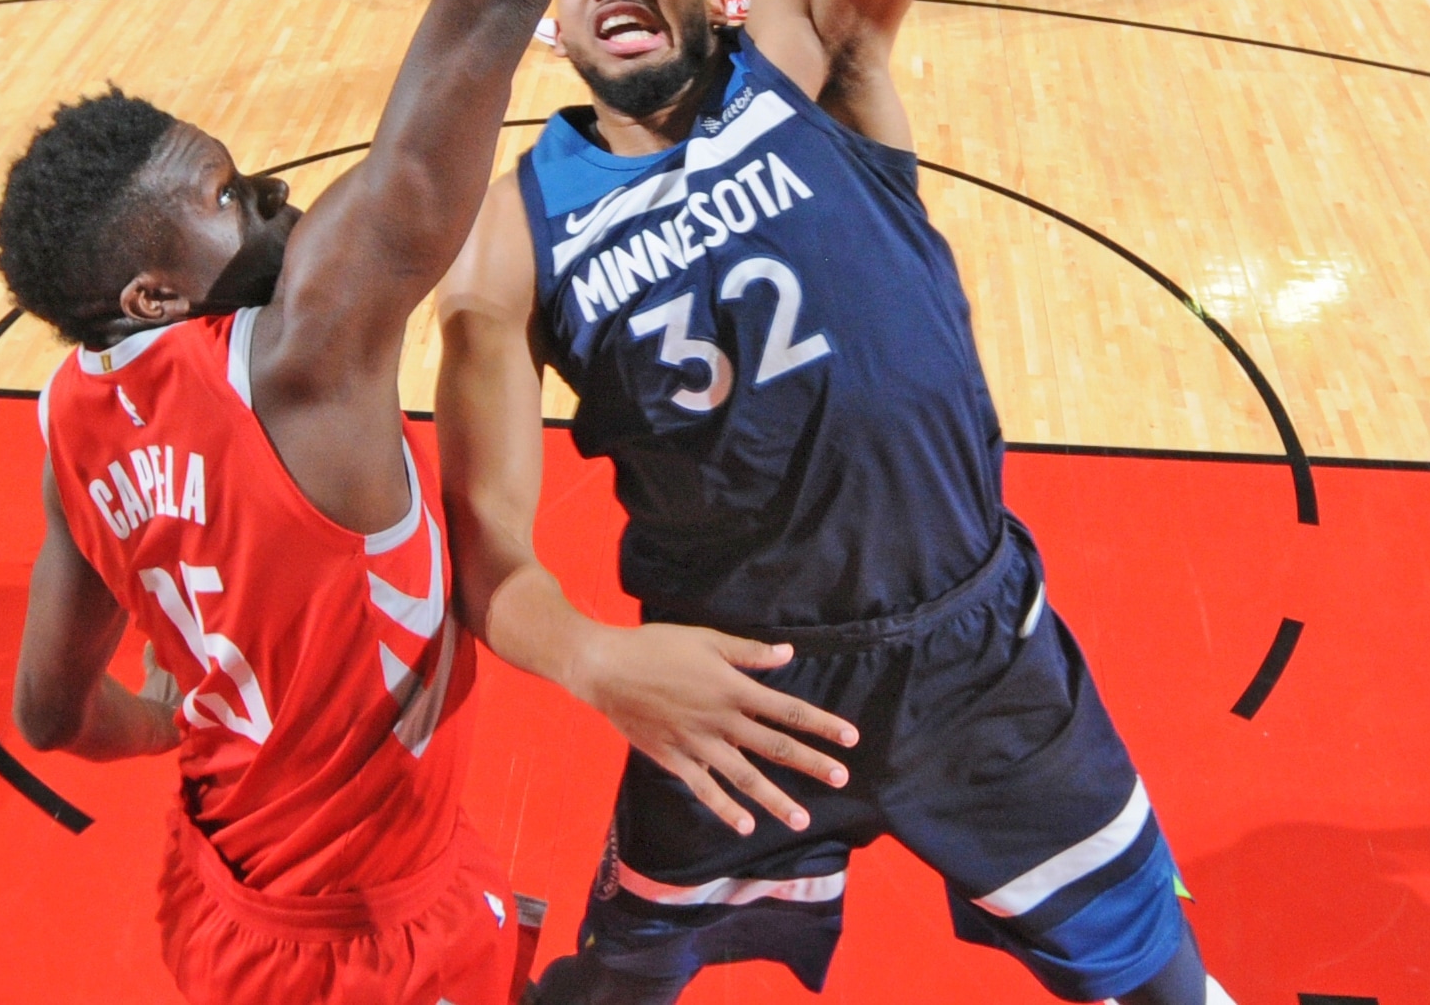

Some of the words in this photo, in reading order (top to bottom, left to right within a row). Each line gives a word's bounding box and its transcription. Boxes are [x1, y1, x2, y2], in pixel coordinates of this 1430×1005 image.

[722, 85, 754, 123] fitbit
[571, 151, 814, 323] MINNESOTA
[628, 256, 833, 412] 32
[89, 445, 206, 540] CAPELA
[138, 560, 274, 745] 15
